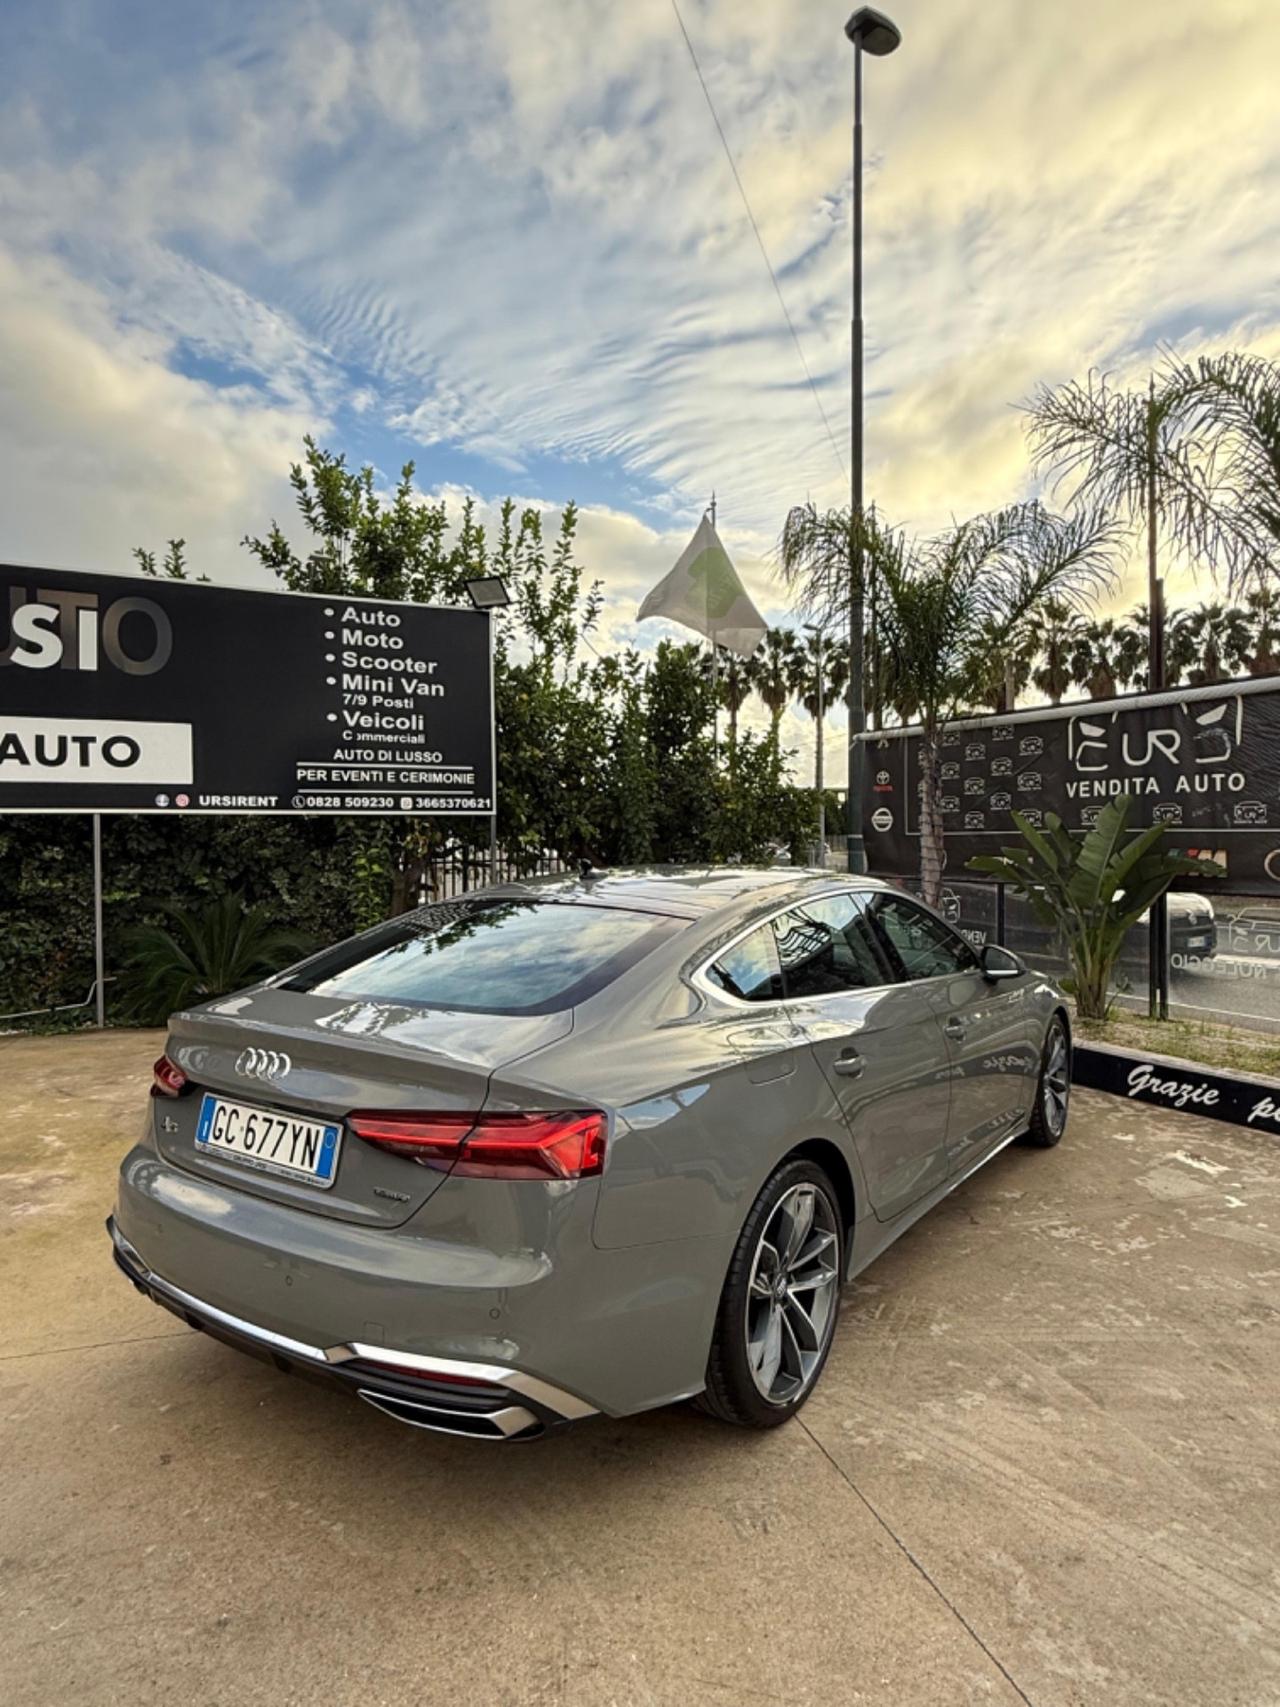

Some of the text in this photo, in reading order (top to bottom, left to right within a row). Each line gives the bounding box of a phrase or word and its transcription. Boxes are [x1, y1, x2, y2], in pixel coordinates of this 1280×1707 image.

[341, 606, 401, 628] Auto
[342, 628, 404, 649] Moto
[342, 651, 438, 674] Scooter
[342, 673, 445, 697] Mini Van
[342, 693, 414, 709] 7/9 Posti
[342, 709, 425, 731] Veicoli
[0, 733, 141, 768] AUTO
[333, 749, 443, 763] AUTO DI LUSSO
[296, 769, 475, 785] PER EVENTI E CERIMONIE
[1065, 772, 1246, 799] VENDITA AUTO
[198, 794, 279, 807] URSIRENT
[307, 796, 394, 808] 0828 509230
[415, 798, 491, 809] 3665370621
[1127, 1064, 1220, 1107] Grazie
